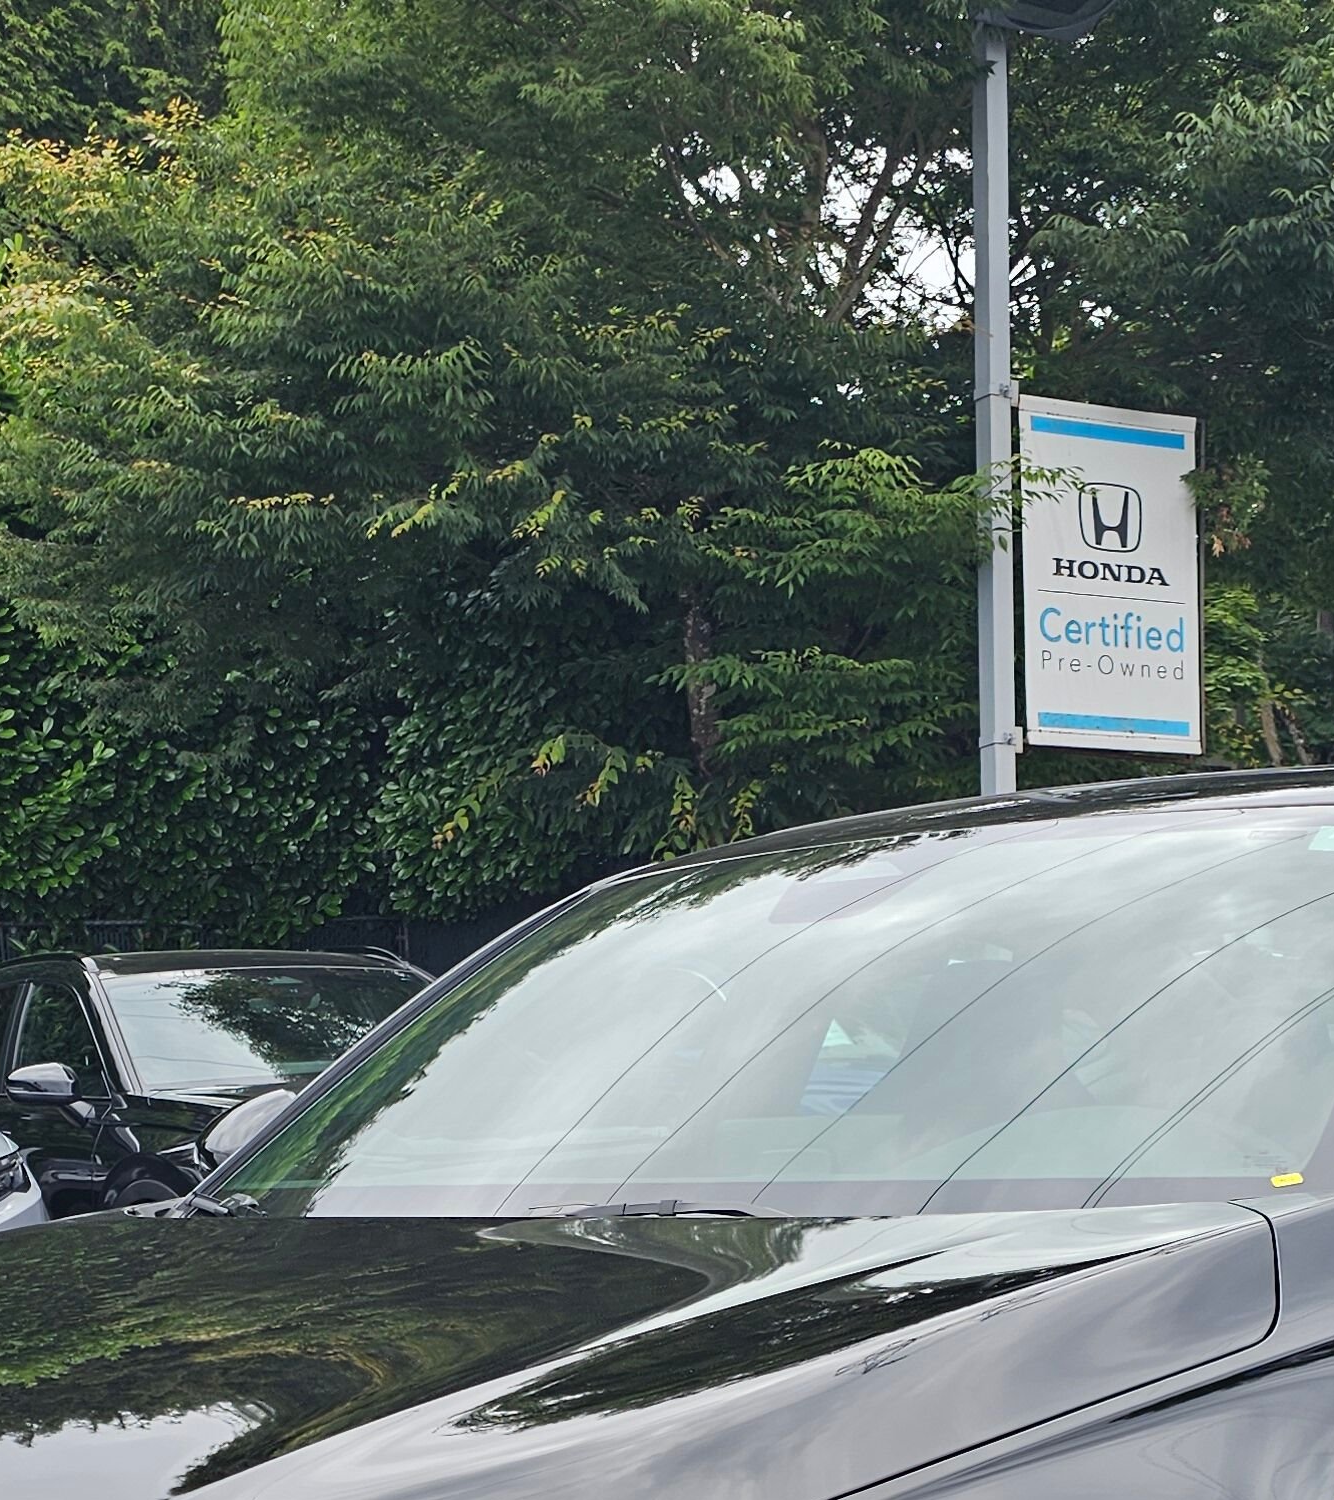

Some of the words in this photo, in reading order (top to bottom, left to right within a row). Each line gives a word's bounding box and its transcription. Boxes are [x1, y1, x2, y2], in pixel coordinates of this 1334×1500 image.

[1052, 557, 1170, 587] HONDA
[1039, 607, 1185, 653] Certified
[1041, 649, 1185, 681] Pre-Owned
